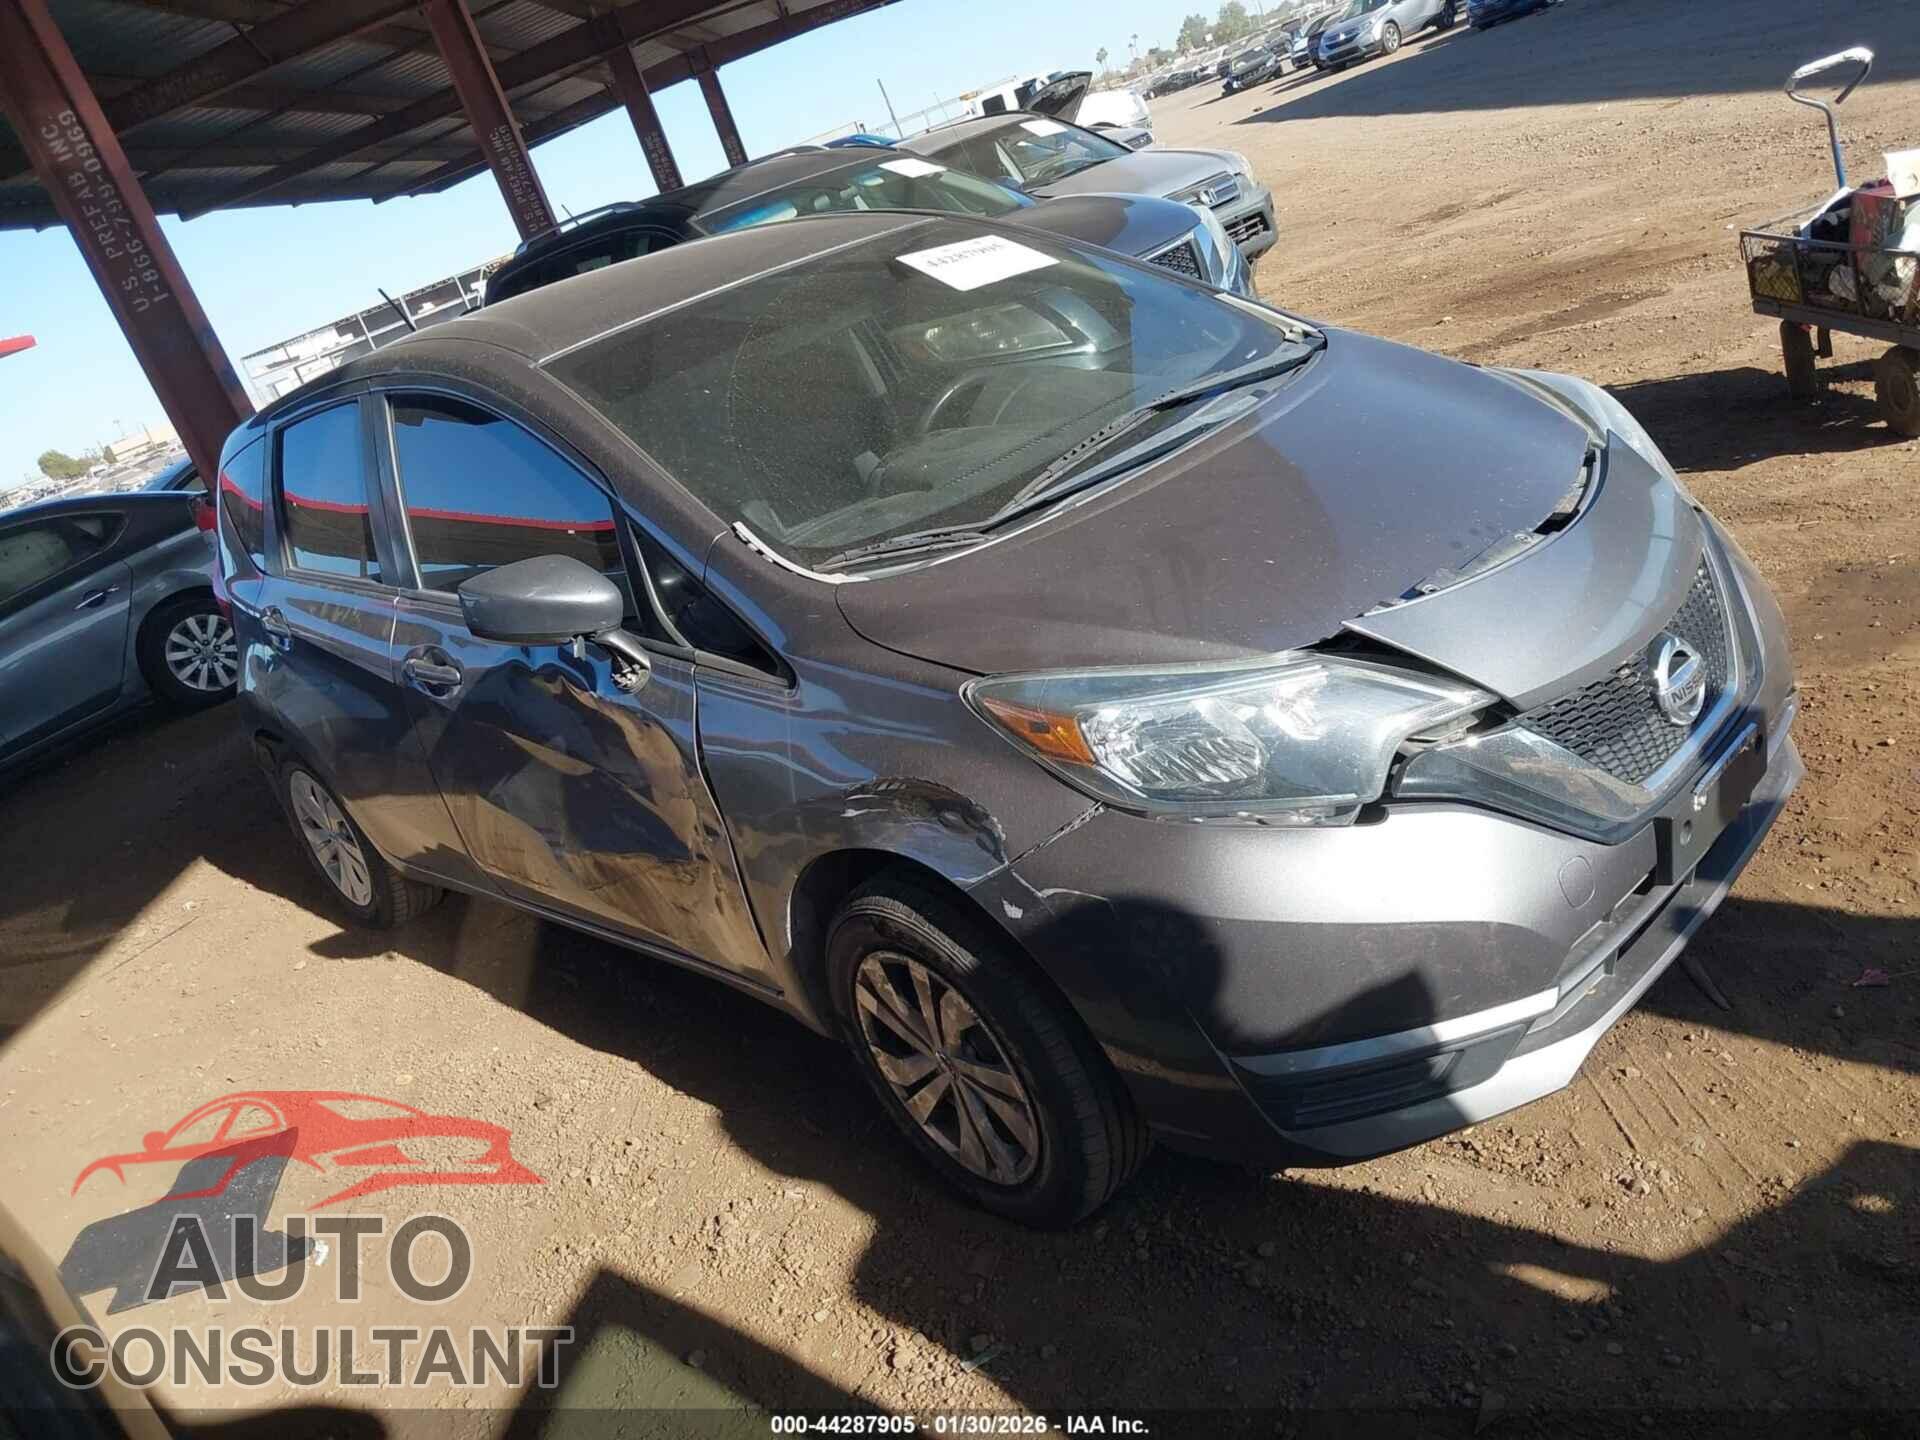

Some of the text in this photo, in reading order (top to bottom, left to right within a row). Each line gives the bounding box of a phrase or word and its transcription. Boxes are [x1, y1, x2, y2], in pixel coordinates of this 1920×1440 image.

[41, 115, 73, 162] INC.
[58, 109, 169, 301] 1-866-799-0969
[68, 173, 123, 258] PREFAB
